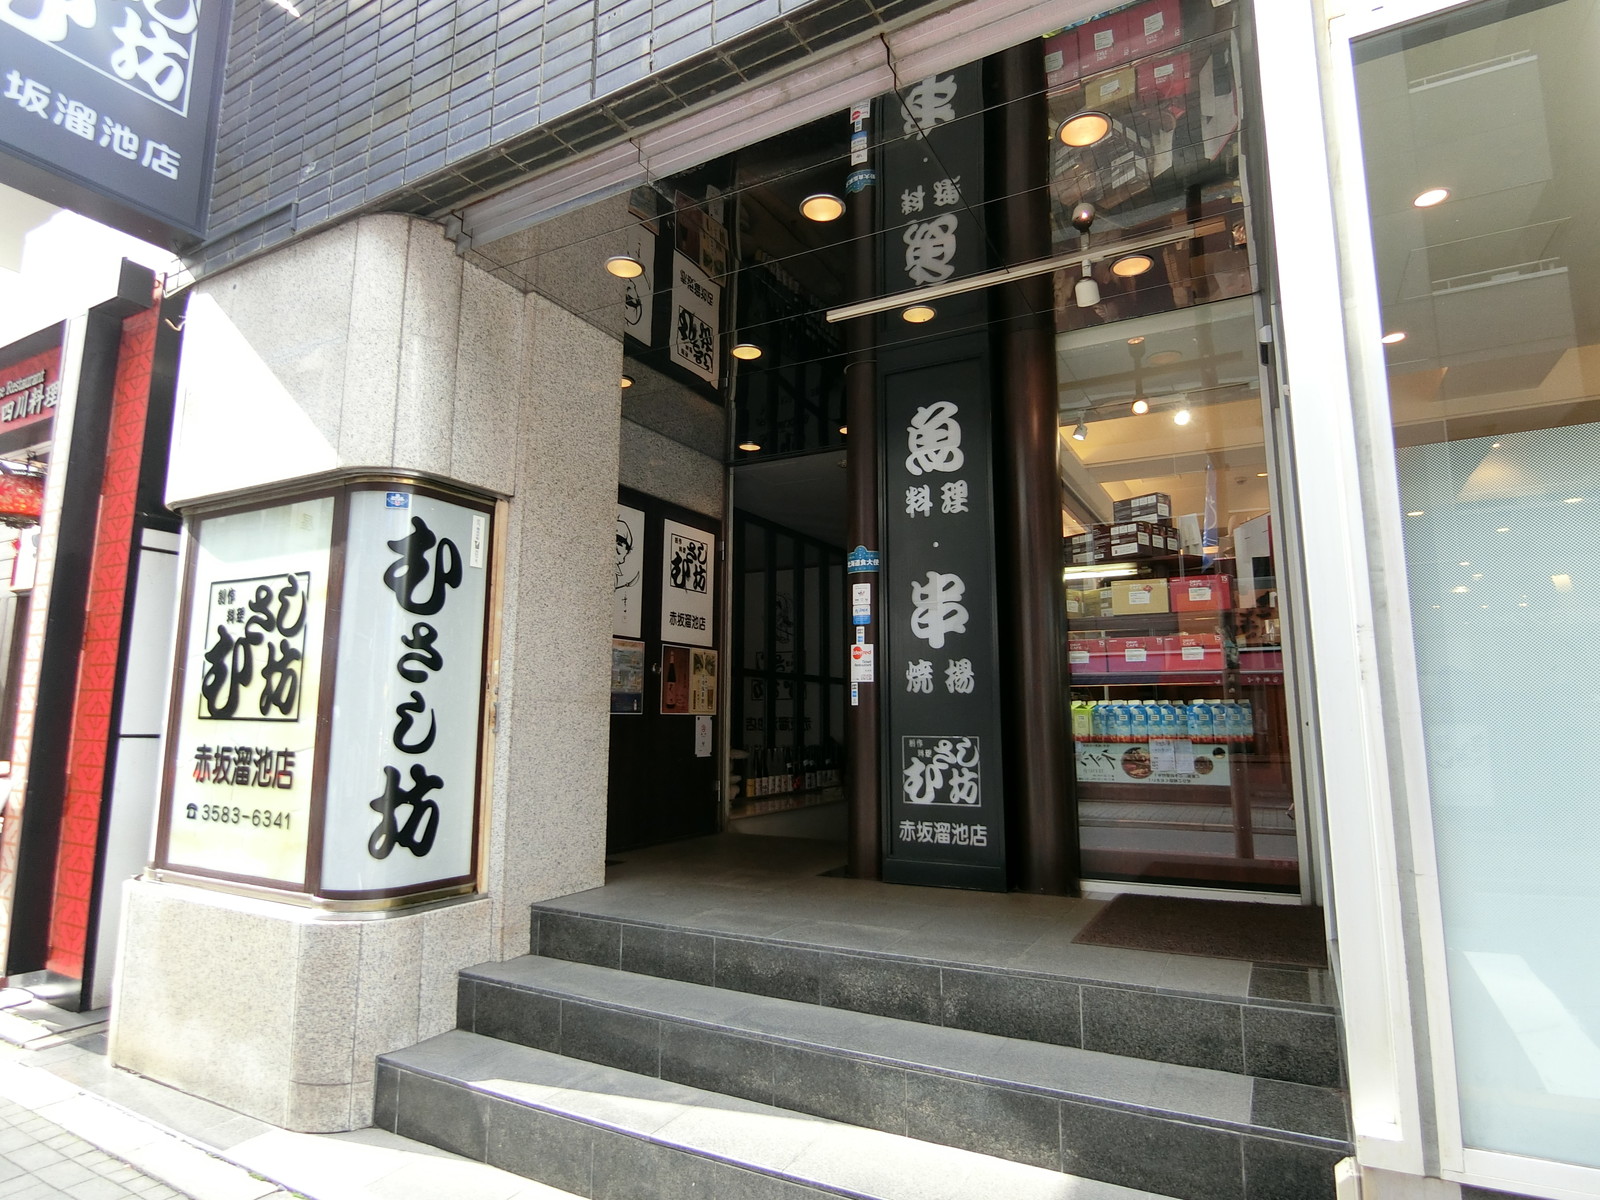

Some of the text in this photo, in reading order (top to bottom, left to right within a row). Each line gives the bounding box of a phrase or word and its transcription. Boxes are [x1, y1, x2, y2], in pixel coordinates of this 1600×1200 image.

[905, 479, 969, 519] 料理
[368, 515, 463, 860] むさし坊
[193, 746, 295, 789] 赤坂溜池店
[201, 803, 291, 830] 3583-6341
[899, 820, 988, 847] 赤坂溜池店
